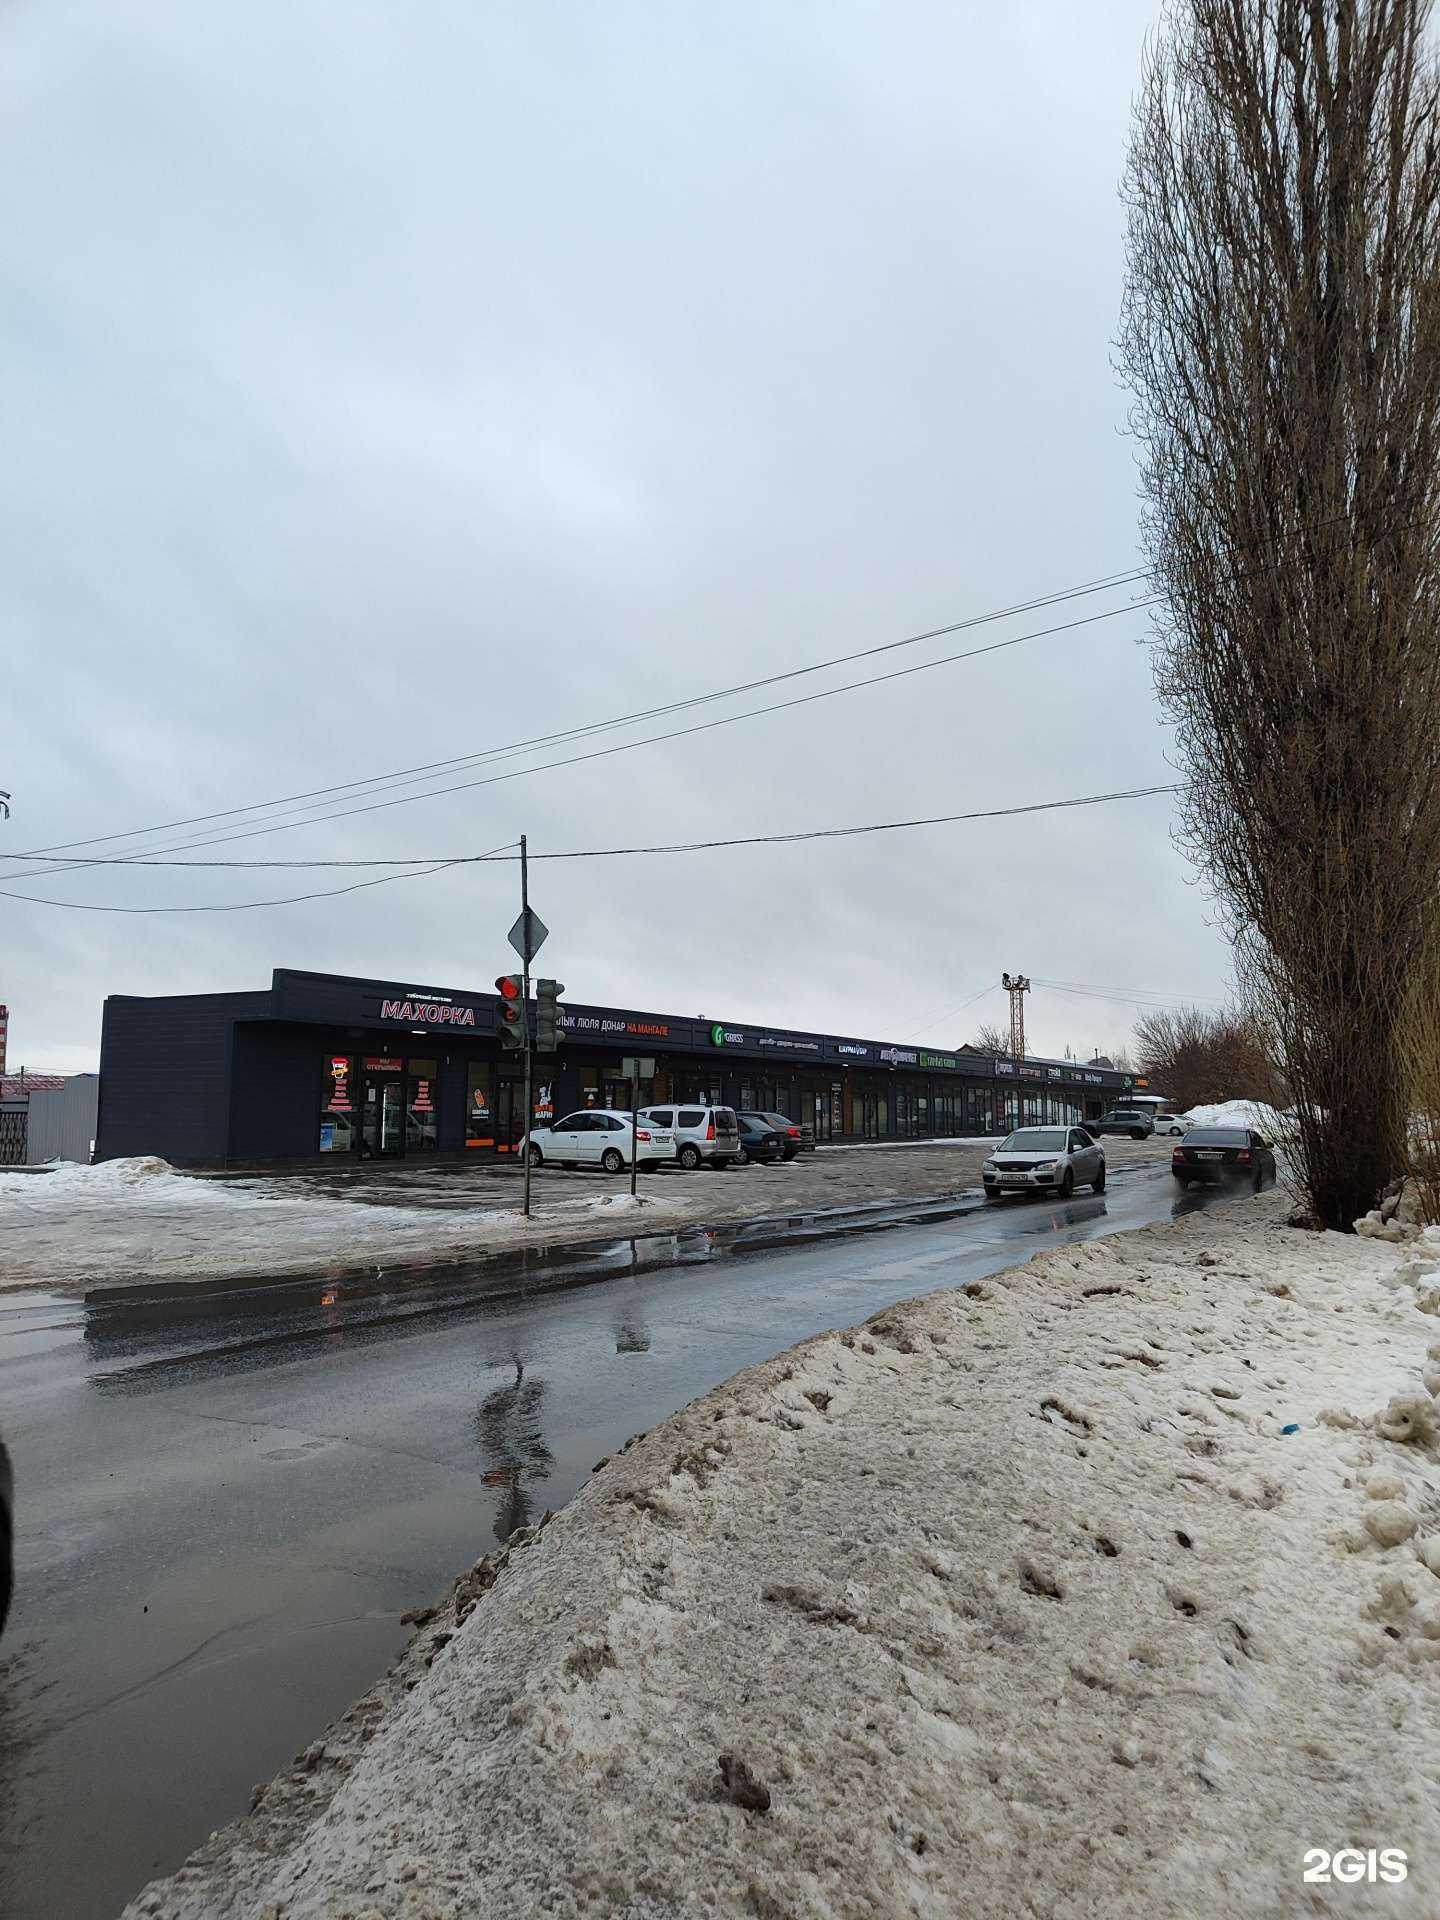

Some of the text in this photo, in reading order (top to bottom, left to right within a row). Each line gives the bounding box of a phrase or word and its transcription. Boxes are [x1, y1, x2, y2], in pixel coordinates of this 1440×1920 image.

[381, 1000, 475, 1026] МАХОРКА
[577, 1017, 600, 1030] ЛЮЛЯ
[627, 1023, 637, 1033] НА
[638, 1024, 668, 1036] МАНГАЛЕ
[724, 1032, 744, 1044] GRASS
